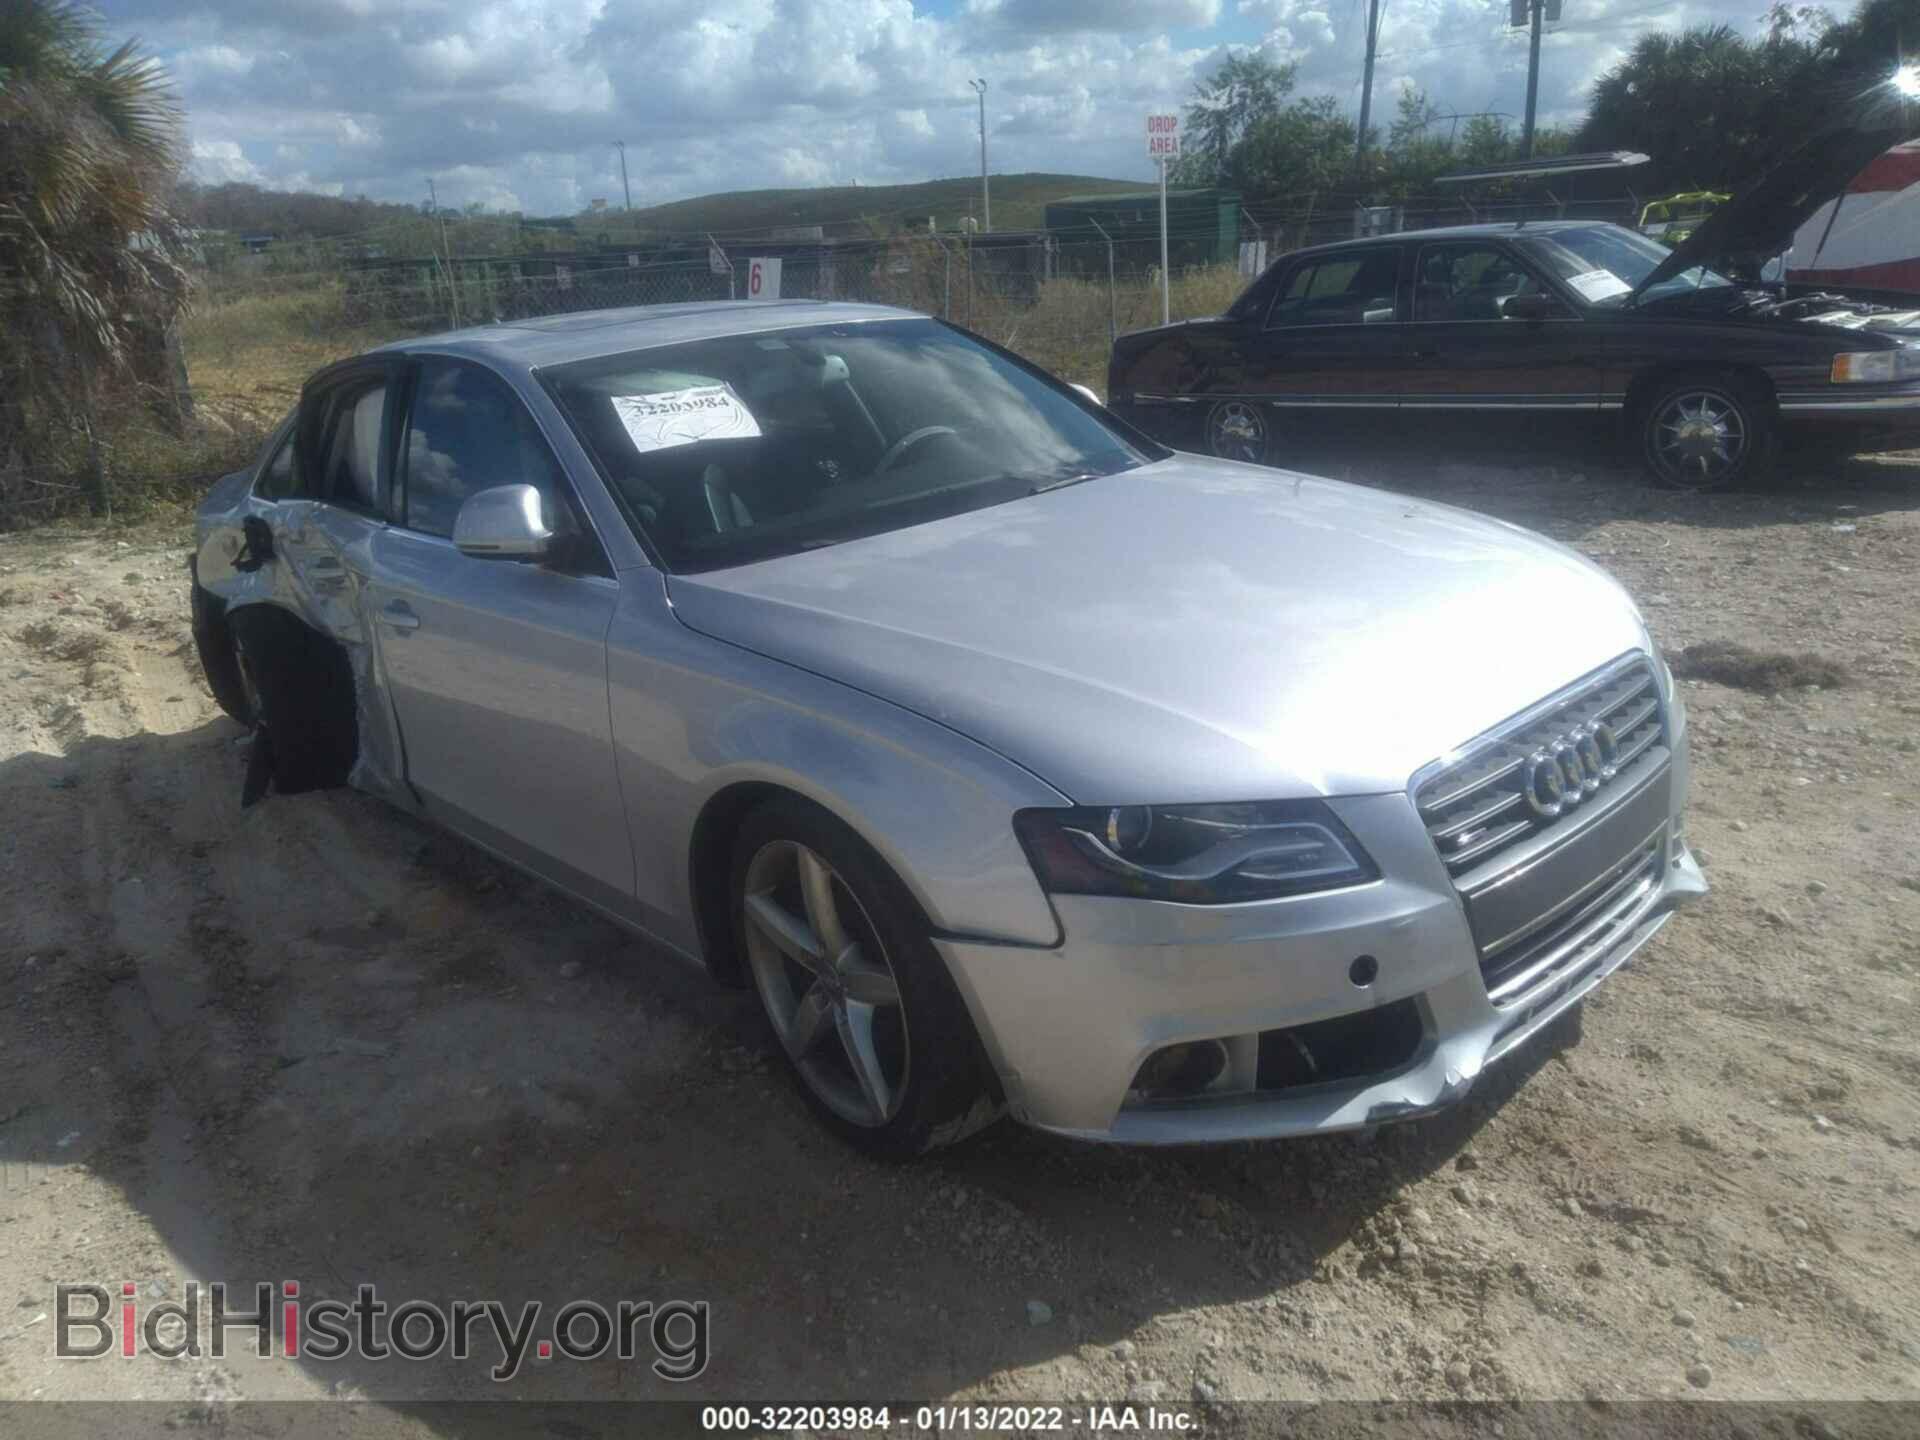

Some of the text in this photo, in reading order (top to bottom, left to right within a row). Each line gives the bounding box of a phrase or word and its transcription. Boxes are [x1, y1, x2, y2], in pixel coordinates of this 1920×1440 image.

[1148, 116, 1177, 132] DROP
[1150, 137, 1178, 153] AREA
[750, 264, 762, 295] 6
